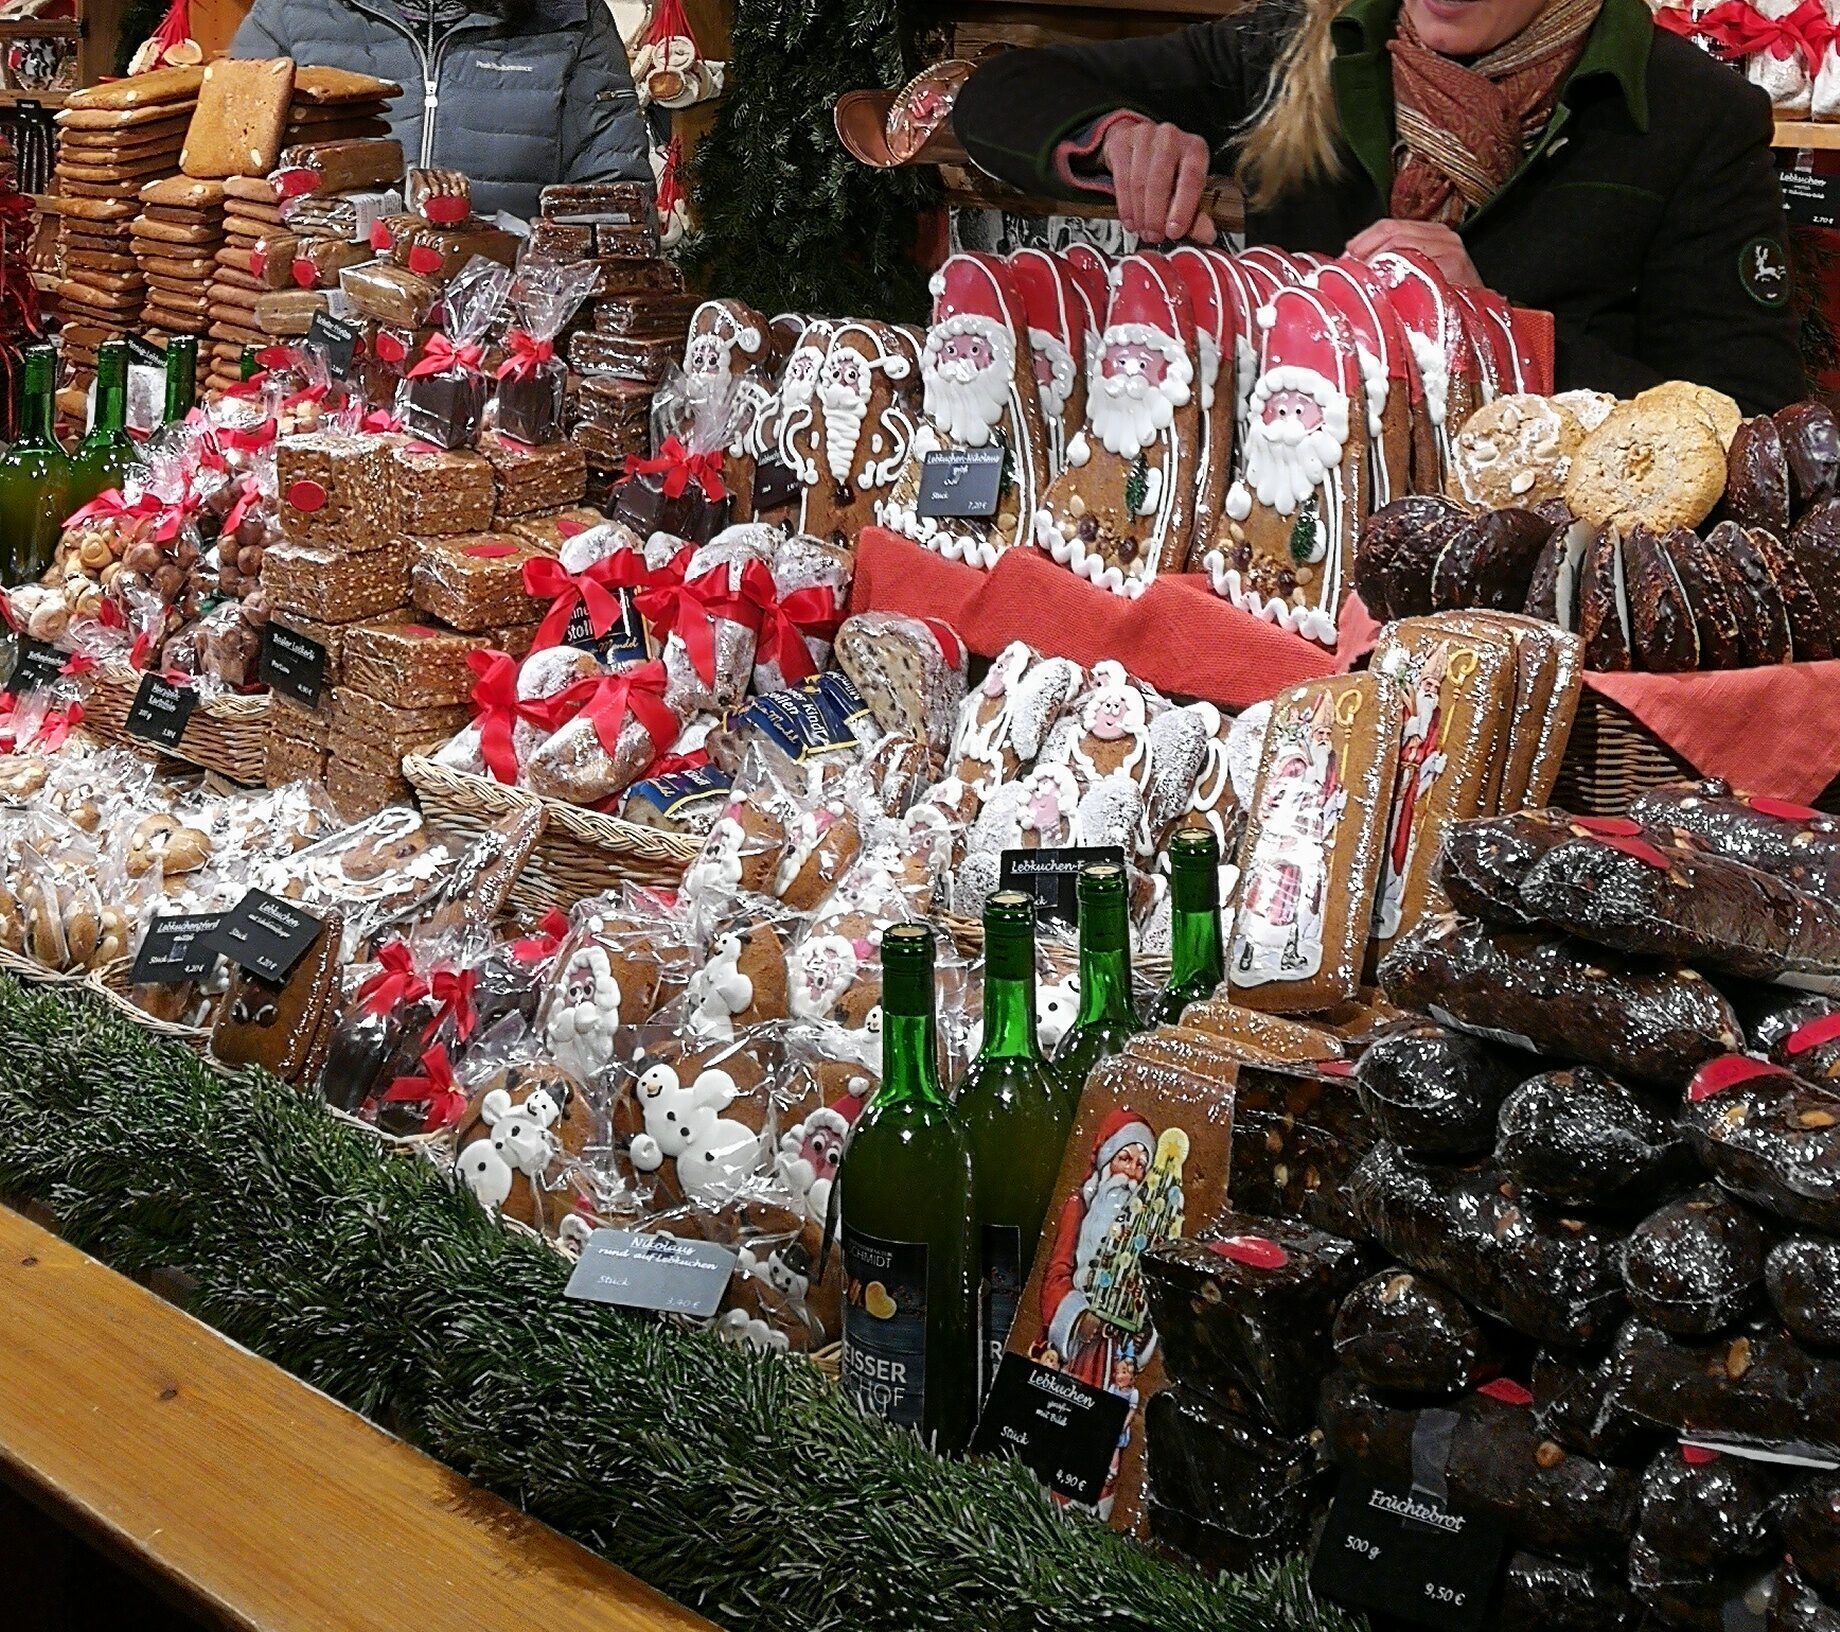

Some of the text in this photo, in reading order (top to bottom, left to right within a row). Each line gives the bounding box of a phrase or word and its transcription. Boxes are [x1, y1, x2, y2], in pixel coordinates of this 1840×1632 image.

[1011, 859, 1086, 873] Lebkuchen-F
[257, 901, 301, 928] Lebkuchen
[598, 1247, 631, 1259] rund
[630, 1236, 697, 1255] Nikolaus
[851, 1245, 892, 1269] CHMIDT
[844, 1341, 907, 1384] EISSER
[1028, 1369, 1096, 1409] Lebkuchen
[1370, 1488, 1467, 1532] Früchtebrot
